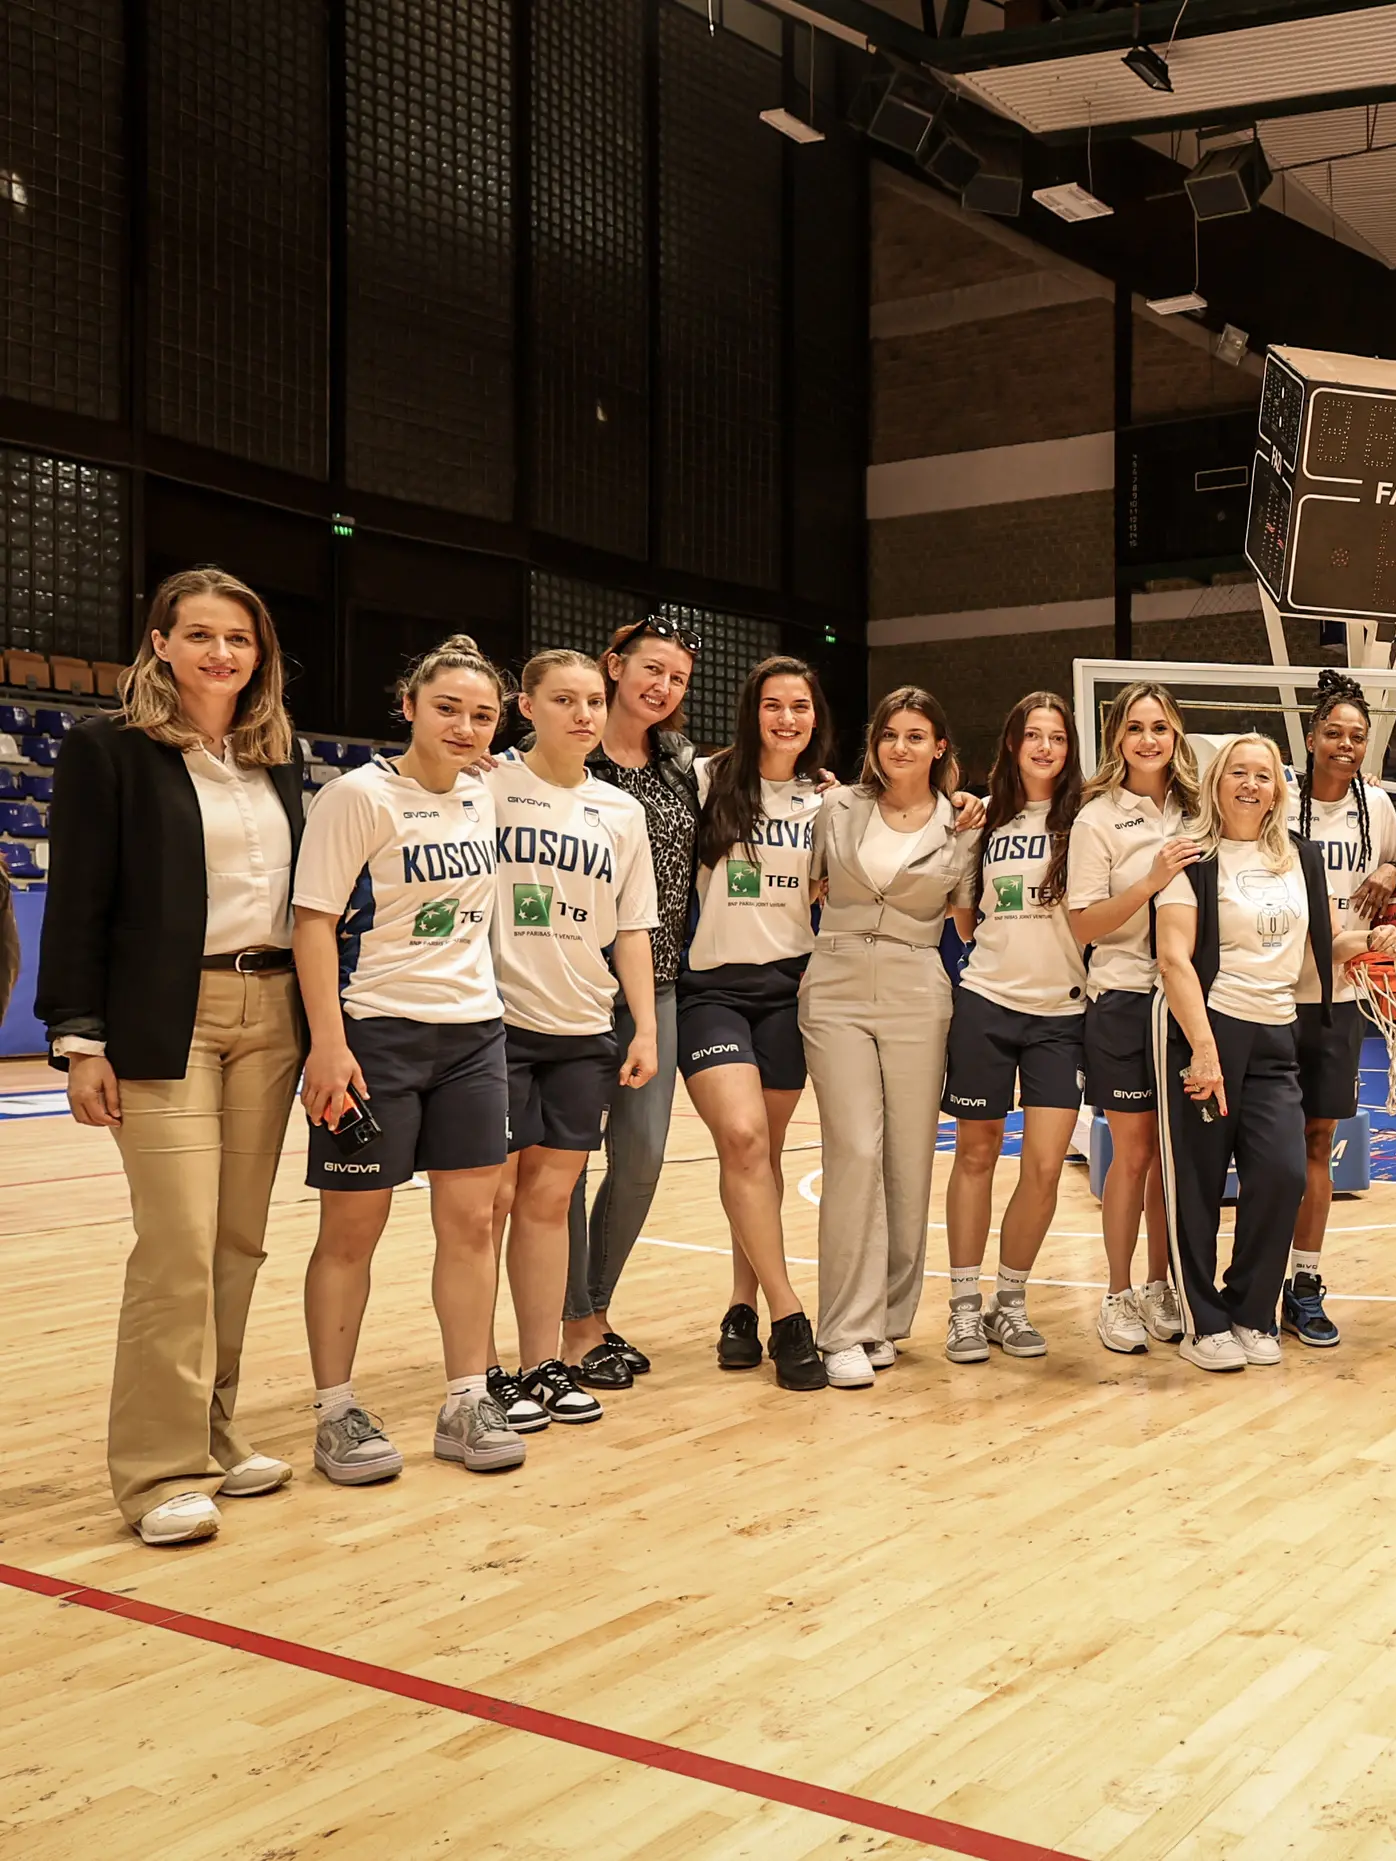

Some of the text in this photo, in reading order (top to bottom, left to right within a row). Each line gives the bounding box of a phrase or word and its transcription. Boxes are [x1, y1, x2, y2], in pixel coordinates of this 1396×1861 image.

[508, 796, 551, 809] GIVOVA
[403, 811, 440, 819] GIVOVA
[1115, 817, 1145, 829] GIVOVA
[496, 826, 612, 883] KOSOVA
[984, 834, 1053, 868] KOSO
[765, 874, 799, 888] TEB
[691, 1043, 739, 1060] GIVOVA
[324, 1161, 380, 1173] GIVOVA
